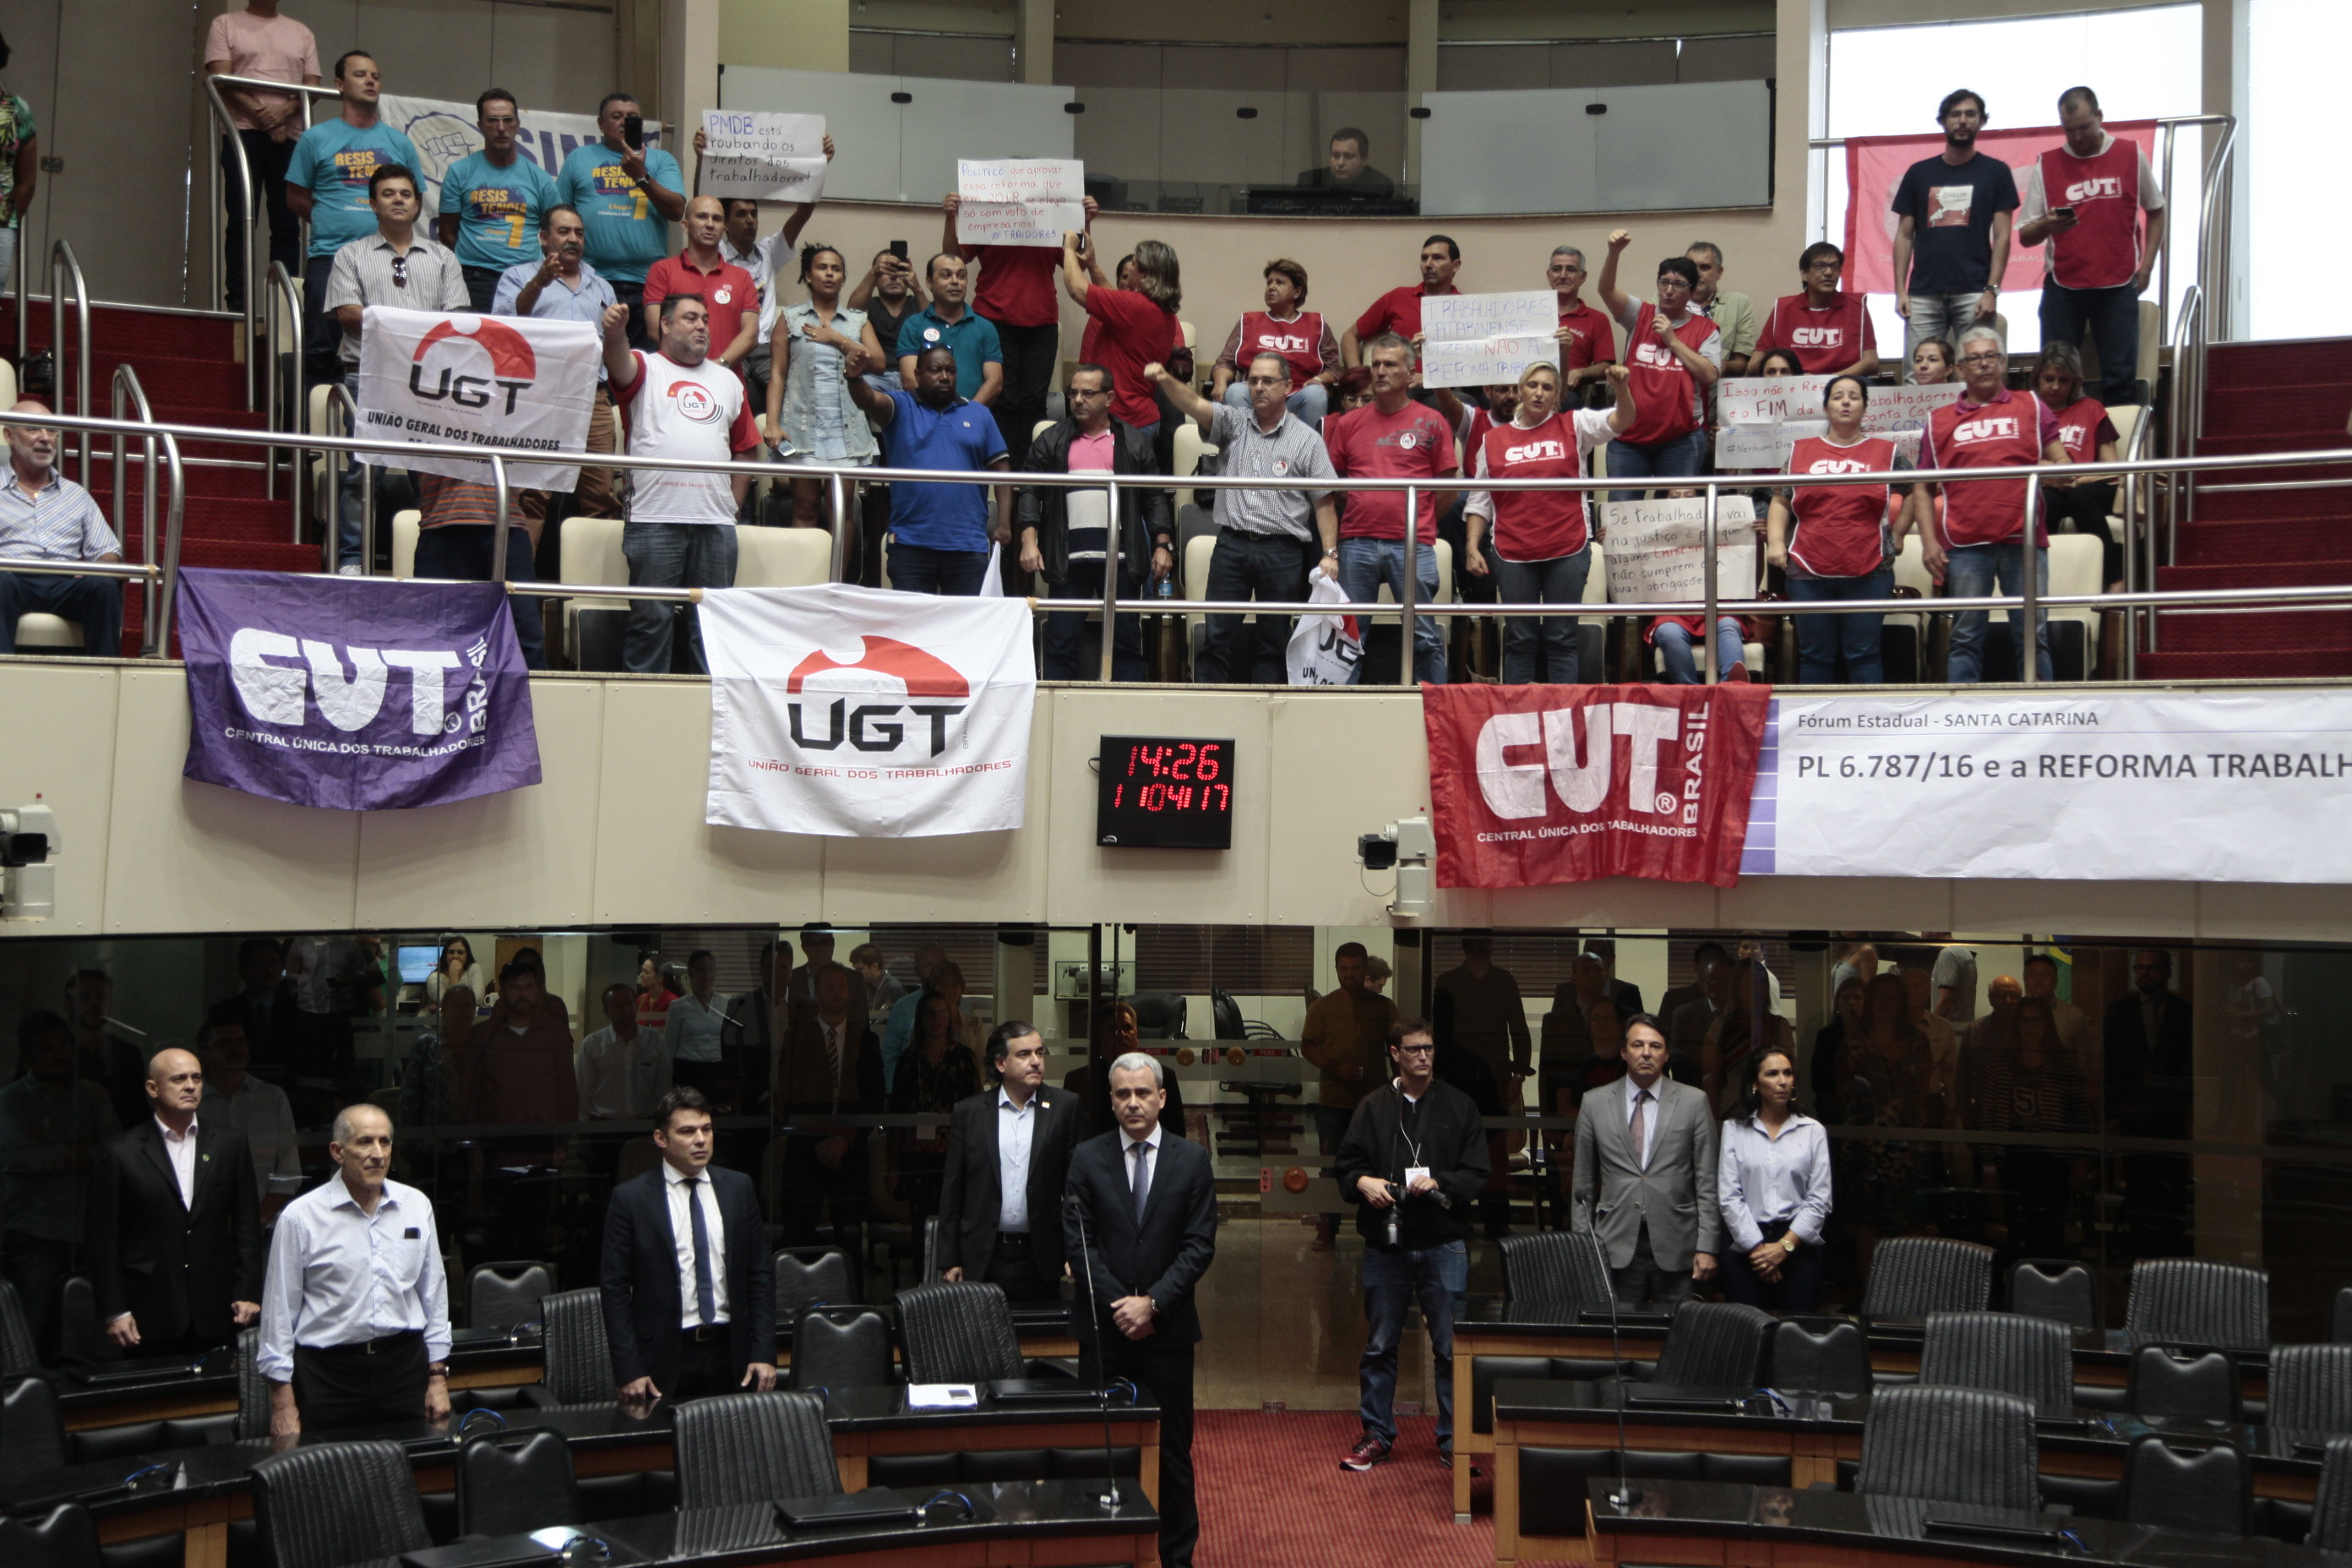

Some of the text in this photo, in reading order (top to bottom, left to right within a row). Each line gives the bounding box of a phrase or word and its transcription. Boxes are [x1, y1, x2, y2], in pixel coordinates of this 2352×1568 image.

[710, 115, 783, 136] PMDB está
[710, 137, 795, 151] roubando os
[335, 149, 375, 167] RESIS
[710, 152, 790, 168] direitos dos
[592, 166, 628, 178] RESI
[1010, 167, 1026, 178] que
[1026, 167, 1063, 177] aprovar
[471, 189, 509, 203] RESIS
[1043, 181, 1062, 193] que
[2066, 177, 2115, 201] CUT
[988, 192, 1020, 204] 2018
[964, 209, 976, 218] só
[1005, 207, 1027, 216] voto
[1031, 207, 1044, 216] de
[505, 215, 525, 248] 7
[1424, 319, 1530, 339] CATARINENSE
[1792, 328, 1838, 345] CUT
[1259, 335, 1304, 350] CUT
[1424, 342, 1478, 357] DIZEM
[1484, 338, 1519, 357] NÃO
[1426, 362, 1489, 380] REFOMA
[409, 363, 534, 416] UGT
[1722, 383, 1757, 398] Isso
[1764, 385, 1783, 395] não
[1756, 399, 1788, 417] FIM
[1796, 403, 1815, 416] da
[368, 411, 561, 451] UNIÃO GERAL DOS TRABALHADORES
[1953, 418, 2012, 441] CUT
[1505, 441, 1558, 461] CUT
[1609, 509, 1628, 525] Se
[1727, 510, 1746, 520] vai
[1611, 537, 1629, 547] na
[1634, 531, 1680, 548] justiça
[1611, 553, 1650, 566] alguns
[1612, 569, 1636, 580] não
[1641, 563, 1694, 579] cumprem
[1614, 577, 1705, 594] suas obrigaçõe
[231, 628, 462, 735] CUT
[466, 635, 488, 734] BRASIL
[787, 696, 968, 759] UGT
[1798, 714, 1852, 728] Fórum
[1858, 714, 1928, 728] Estadual
[1944, 713, 2002, 727] SANTA
[2007, 711, 2099, 727] CATARINA
[225, 727, 486, 757] CENTRAL ÚNICA DOS TRABALHADORES
[749, 759, 1012, 780] UNIÃO GERAL DOS TRABALHADORES
[1128, 743, 1220, 781] 14:26
[1476, 702, 1680, 819] CUT
[1683, 701, 1709, 824] BRASIL
[1798, 752, 2352, 782] PL 6.787/16 e a REFORMA TRABALH
[1477, 820, 1697, 842] CENTRAL ÚNICA DOS TABALHADORES
